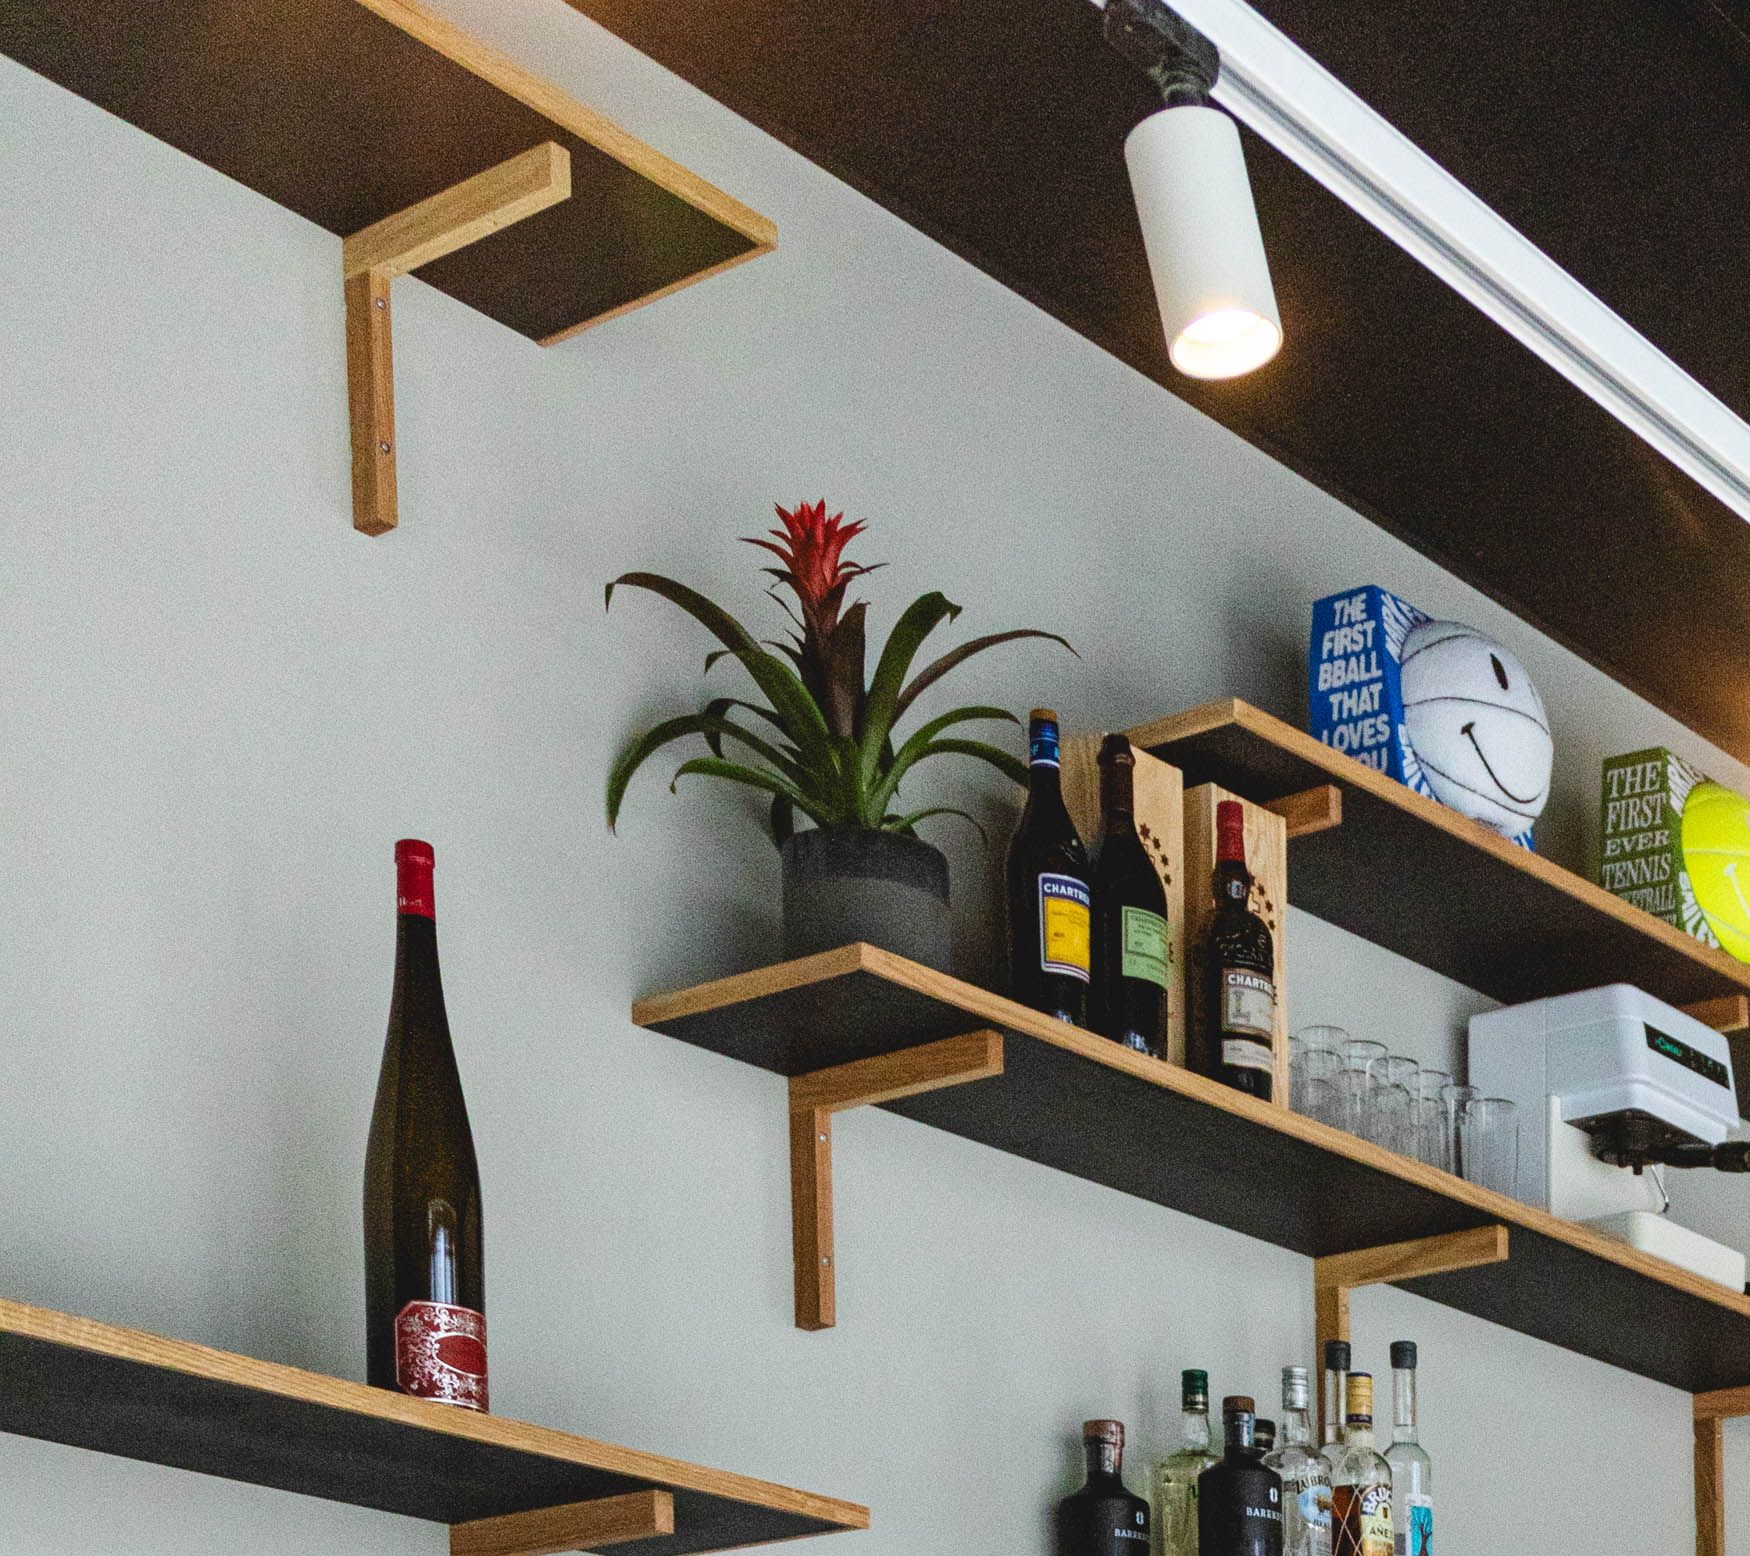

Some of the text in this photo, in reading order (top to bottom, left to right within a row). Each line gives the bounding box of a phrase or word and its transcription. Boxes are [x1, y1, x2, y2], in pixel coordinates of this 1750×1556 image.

[1334, 593, 1367, 626] THE
[1322, 621, 1376, 659] FIRST
[1318, 651, 1383, 692] BBALL
[1329, 684, 1383, 721] THAT
[1606, 762, 1661, 798] THE
[1606, 793, 1667, 833] FIRST
[1605, 830, 1669, 856] EVER
[1603, 854, 1672, 889] TENNIS
